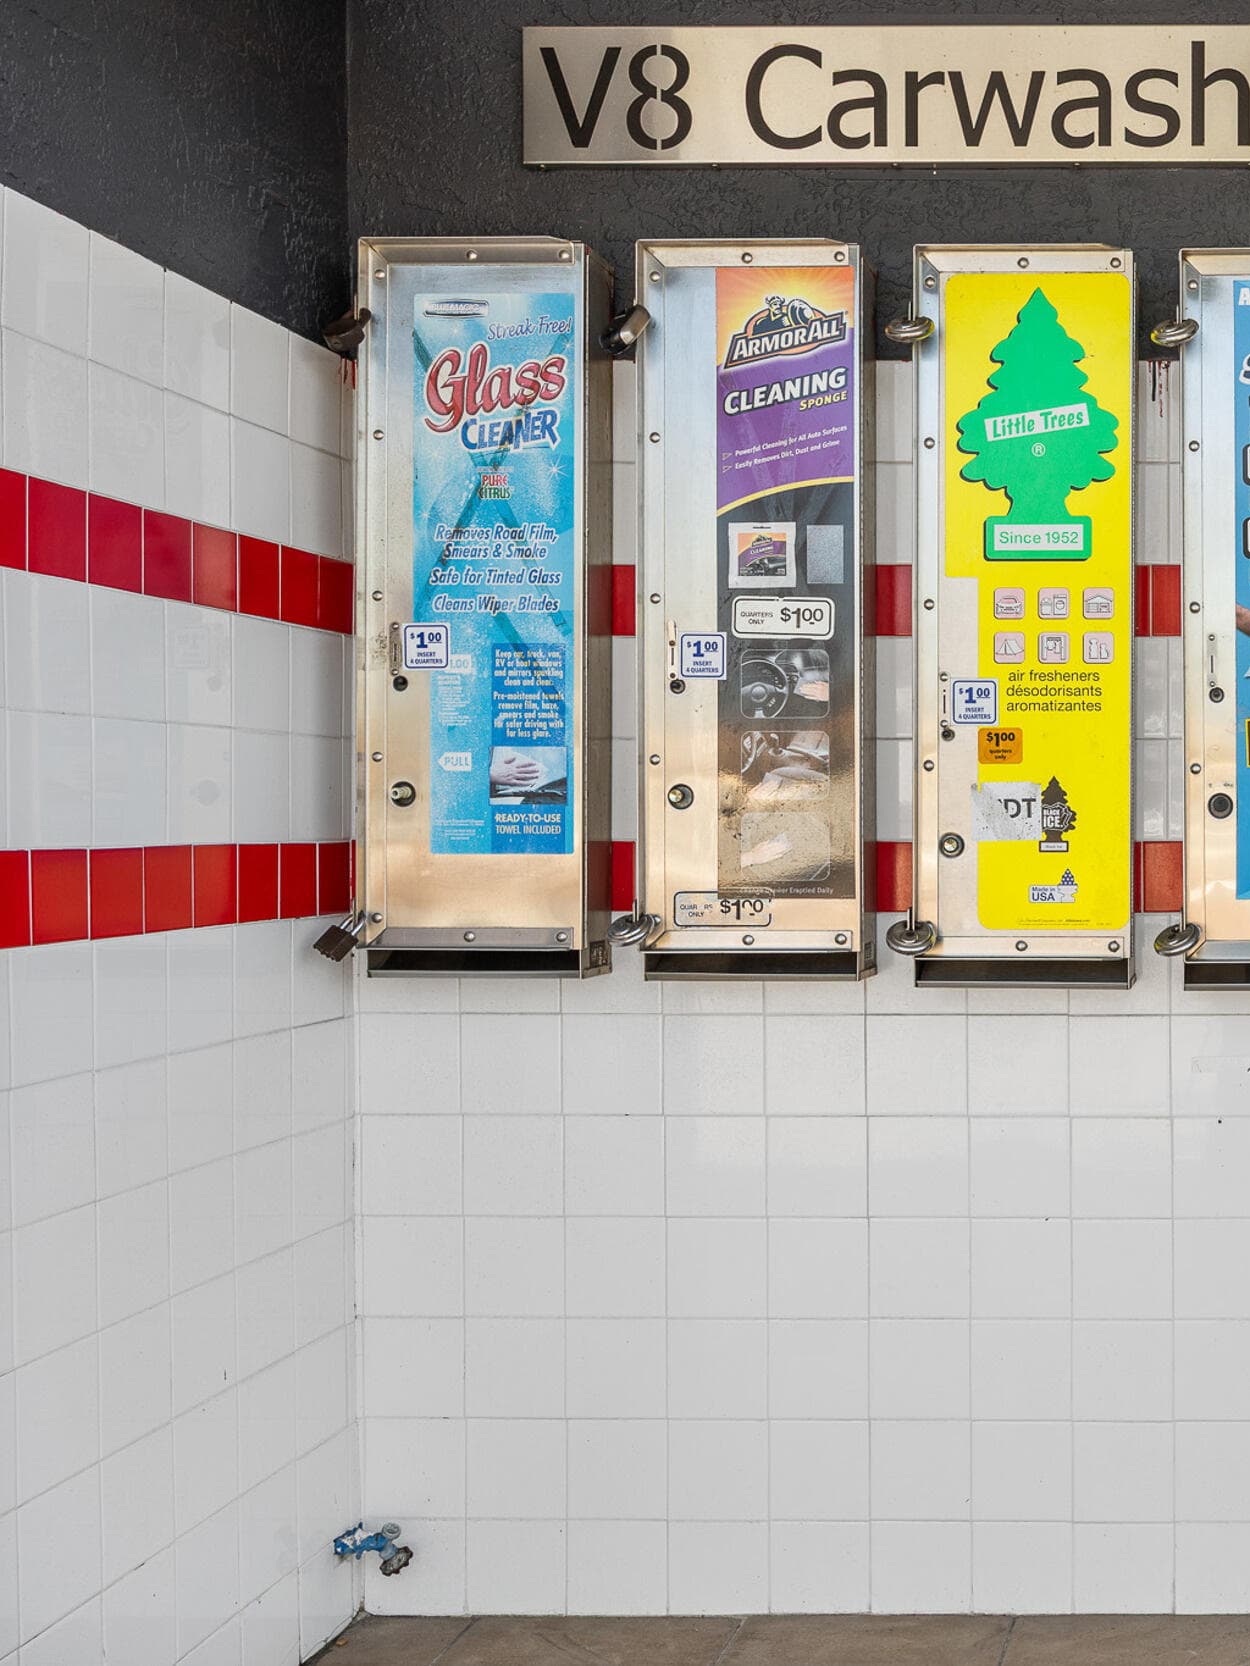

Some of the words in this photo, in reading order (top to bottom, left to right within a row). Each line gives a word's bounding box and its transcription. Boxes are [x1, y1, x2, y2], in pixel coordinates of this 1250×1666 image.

[539, 44, 692, 150] V8
[745, 41, 1250, 150] Carwash
[488, 318, 534, 340] Streak
[538, 315, 572, 334] Free!
[425, 343, 566, 433] Glass
[724, 368, 846, 414] CLEANING
[799, 390, 847, 411] SPONGE
[462, 409, 558, 449] CLEANER
[992, 416, 1035, 439] Little
[1040, 410, 1084, 430] Trees
[735, 444, 761, 456] Powerful
[762, 438, 788, 450] Cleaning
[788, 436, 798, 445] for
[808, 432, 821, 440] Auto
[822, 424, 848, 436] Surfaces
[736, 460, 752, 470] Easily
[754, 453, 780, 465] Removes
[810, 444, 821, 452] and
[482, 474, 507, 486] PURE
[479, 486, 511, 498] CITRUS
[435, 525, 490, 540] Removes
[494, 524, 526, 540] Road
[529, 524, 558, 542] Film,
[999, 531, 1041, 544] Since
[1045, 532, 1078, 544] 1952
[444, 543, 488, 558] Smears
[492, 543, 502, 558] &
[506, 543, 546, 558] Smoke
[431, 568, 460, 584] Safe
[463, 568, 482, 584] for
[487, 568, 524, 584] Tinted
[528, 568, 560, 584] Glass
[434, 595, 474, 611] Cleans
[478, 596, 514, 614] Wiper
[518, 596, 559, 611] Blades
[495, 649, 512, 660] Keep
[495, 659, 505, 667] RV
[1008, 670, 1026, 682] air
[1029, 670, 1100, 682] fresheners
[1006, 684, 1102, 697] désodorisants
[1006, 700, 1102, 712] aromatizantes
[495, 814, 561, 822] READY-TO-USE
[496, 825, 521, 834] TOWEL
[523, 825, 561, 834] INCLUDED
[817, 887, 834, 896] Daily
[1032, 893, 1055, 901] USA
